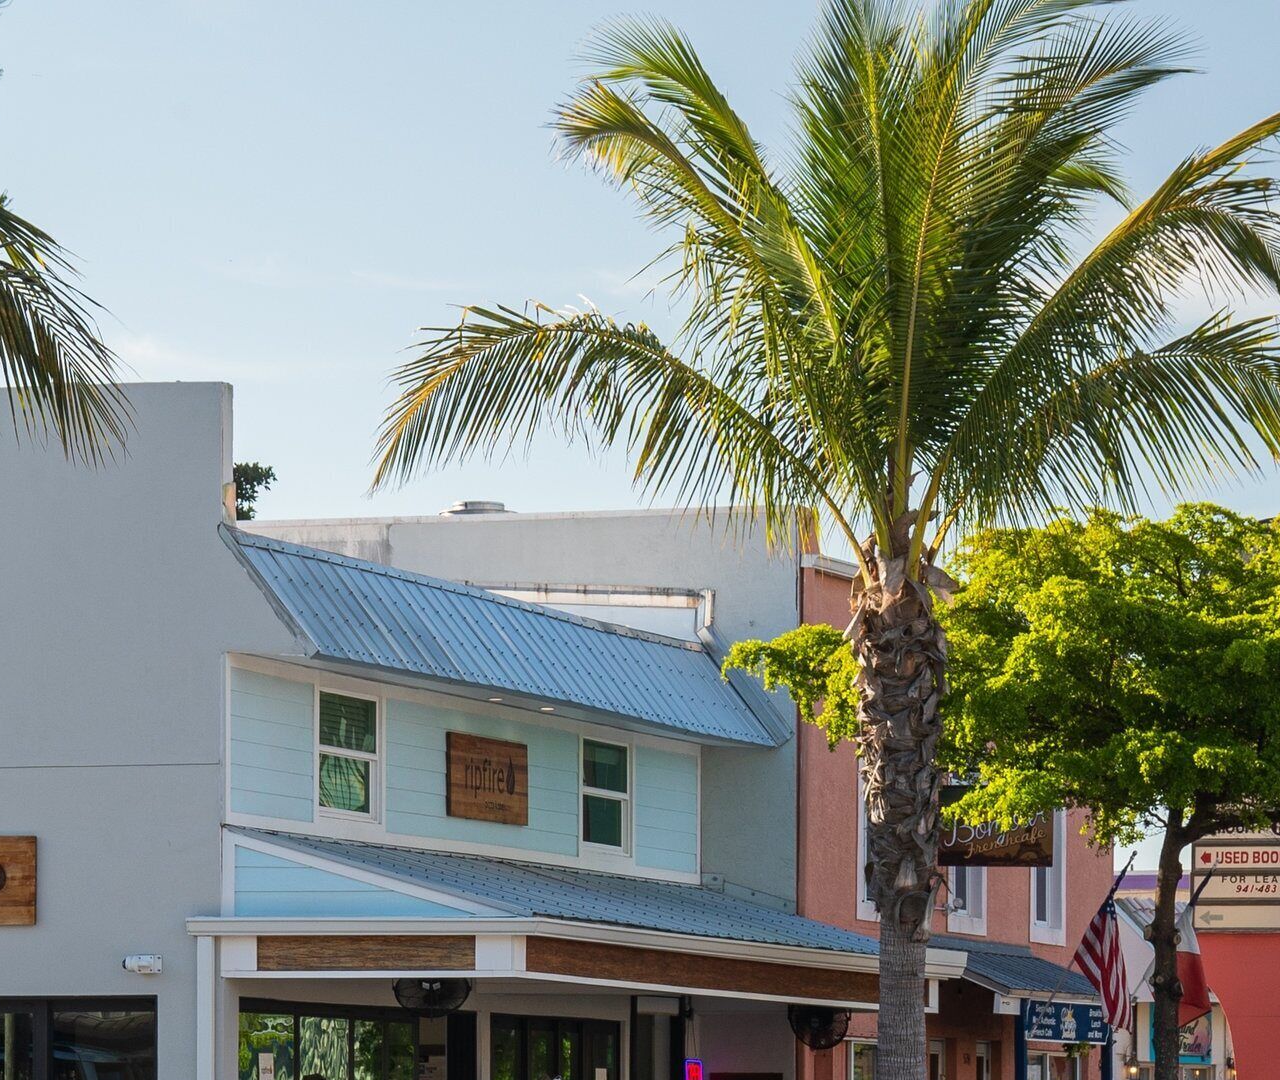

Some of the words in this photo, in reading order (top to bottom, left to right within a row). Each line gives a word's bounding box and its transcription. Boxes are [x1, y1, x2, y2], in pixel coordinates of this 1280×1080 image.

[464, 757, 505, 798] ripfire
[1216, 851, 1249, 864] USED
[1221, 875, 1246, 884] FOR
